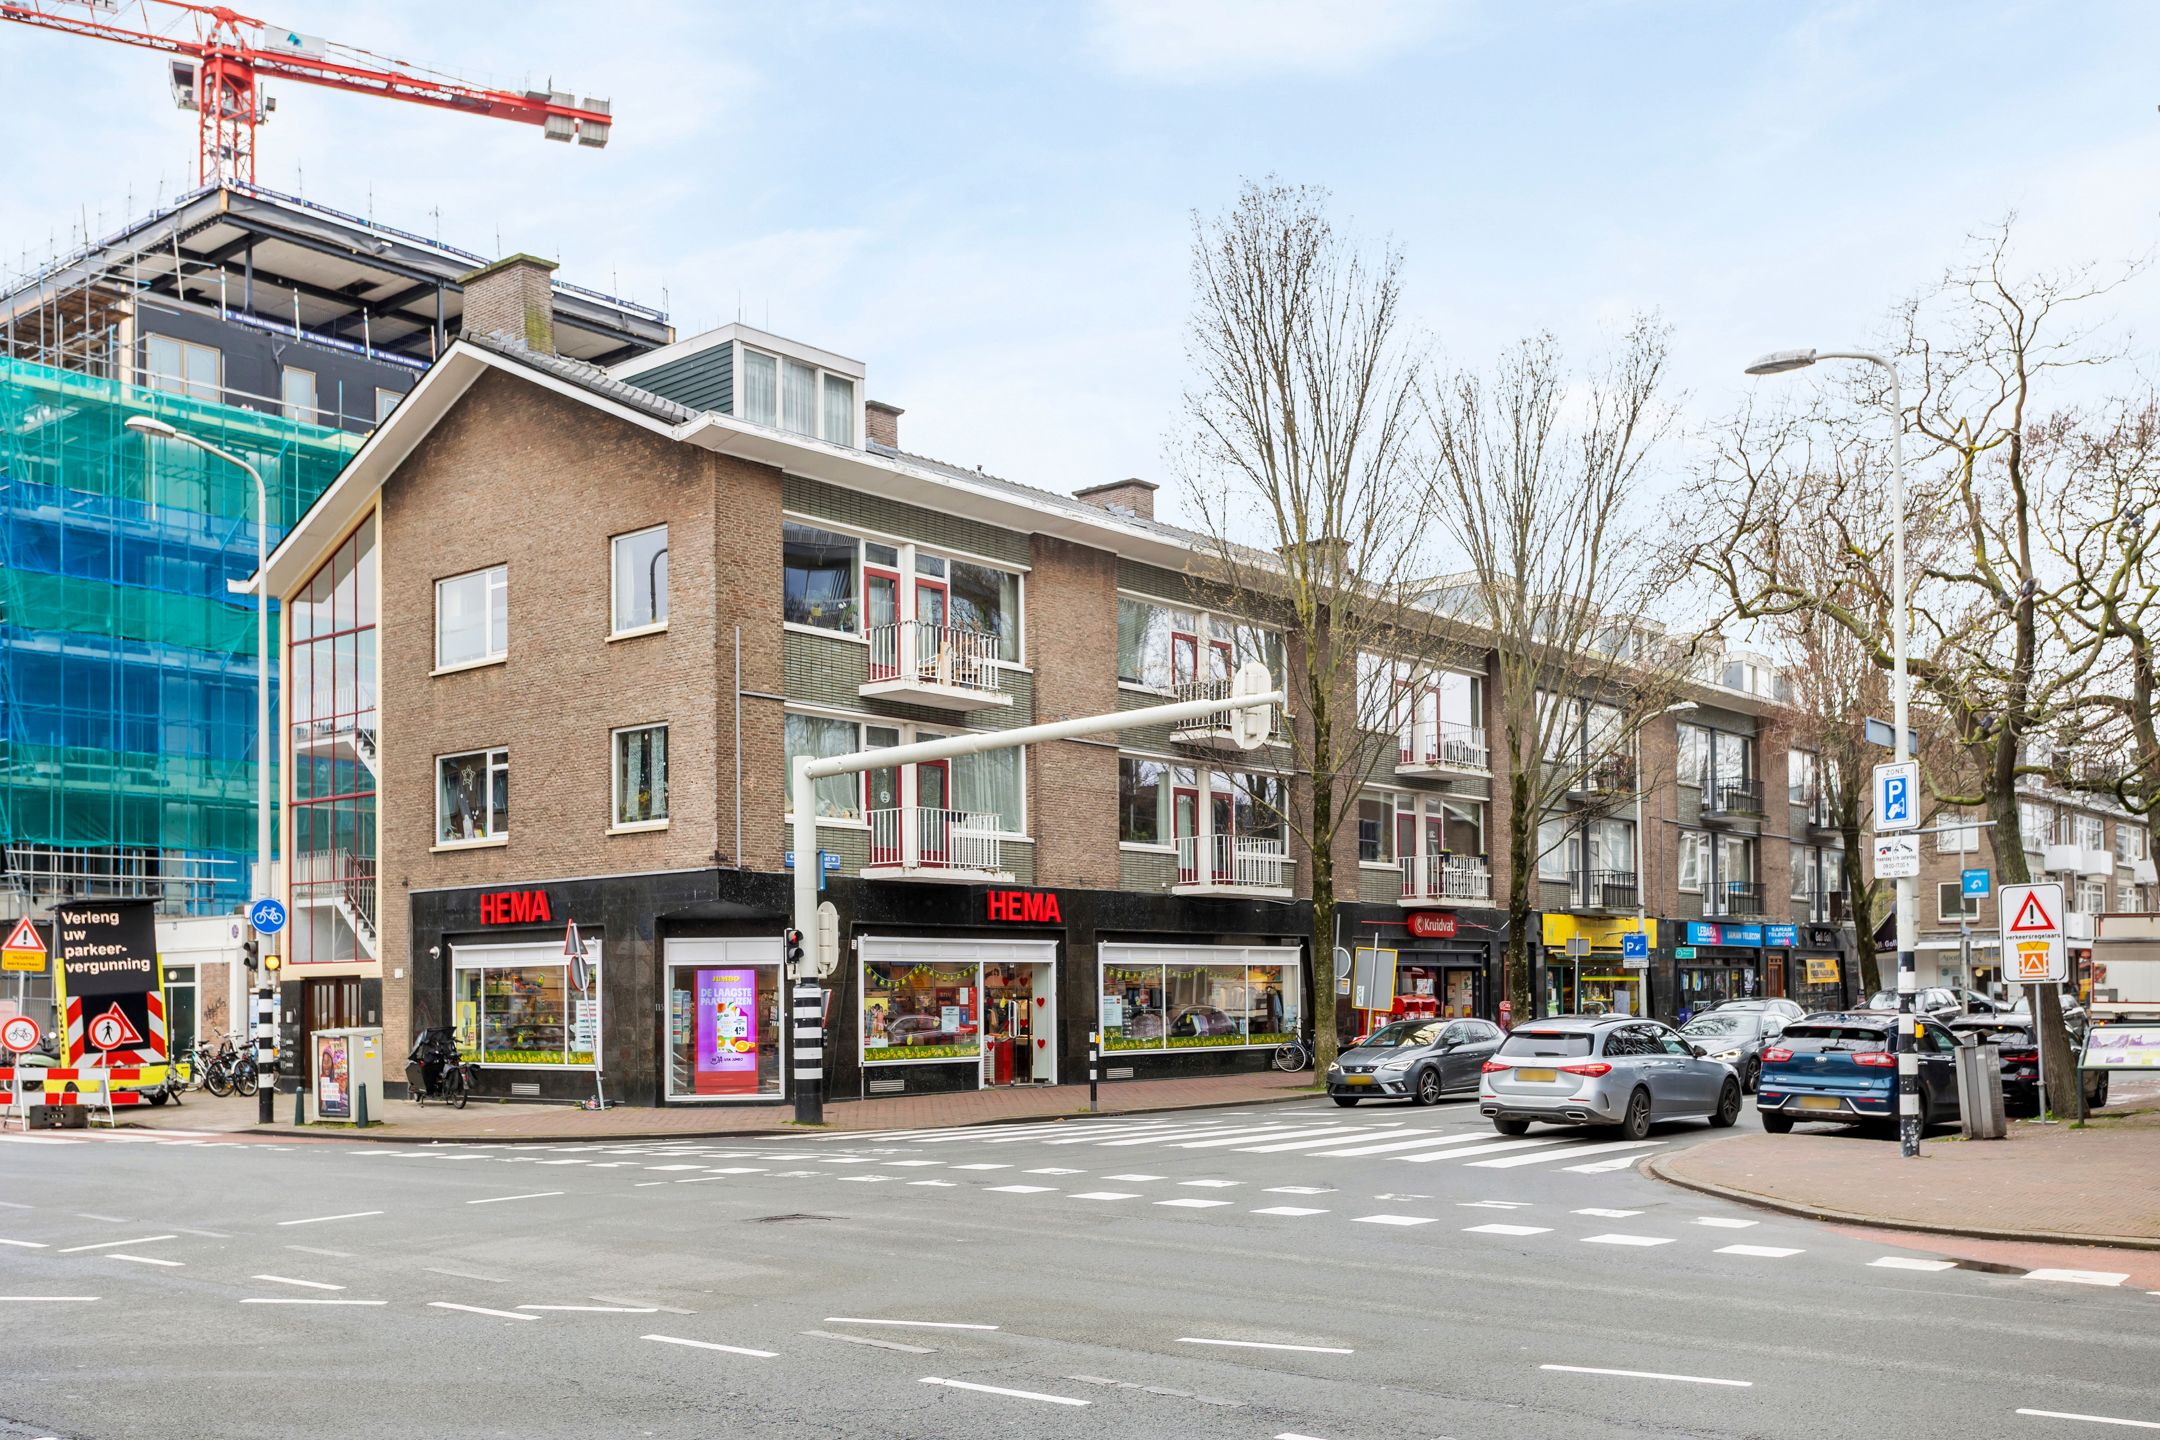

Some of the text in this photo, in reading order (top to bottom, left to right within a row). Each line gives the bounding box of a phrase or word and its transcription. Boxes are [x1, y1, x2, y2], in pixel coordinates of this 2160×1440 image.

[1886, 768, 1904, 776] ZONE
[1888, 780, 1902, 804] P
[481, 890, 551, 924] HEMA
[988, 889, 1062, 922] HEMA
[62, 910, 120, 926] Verleng
[1424, 918, 1454, 932] Kruidvat
[64, 930, 86, 941] uw
[1697, 926, 1717, 937] LEBARA
[1727, 931, 1760, 940] SAMAN TELECOM
[64, 943, 128, 960] parkeer-
[1626, 942, 1633, 952] P
[66, 957, 150, 975] vergunning
[701, 988, 752, 997] DE LAAGSTE
